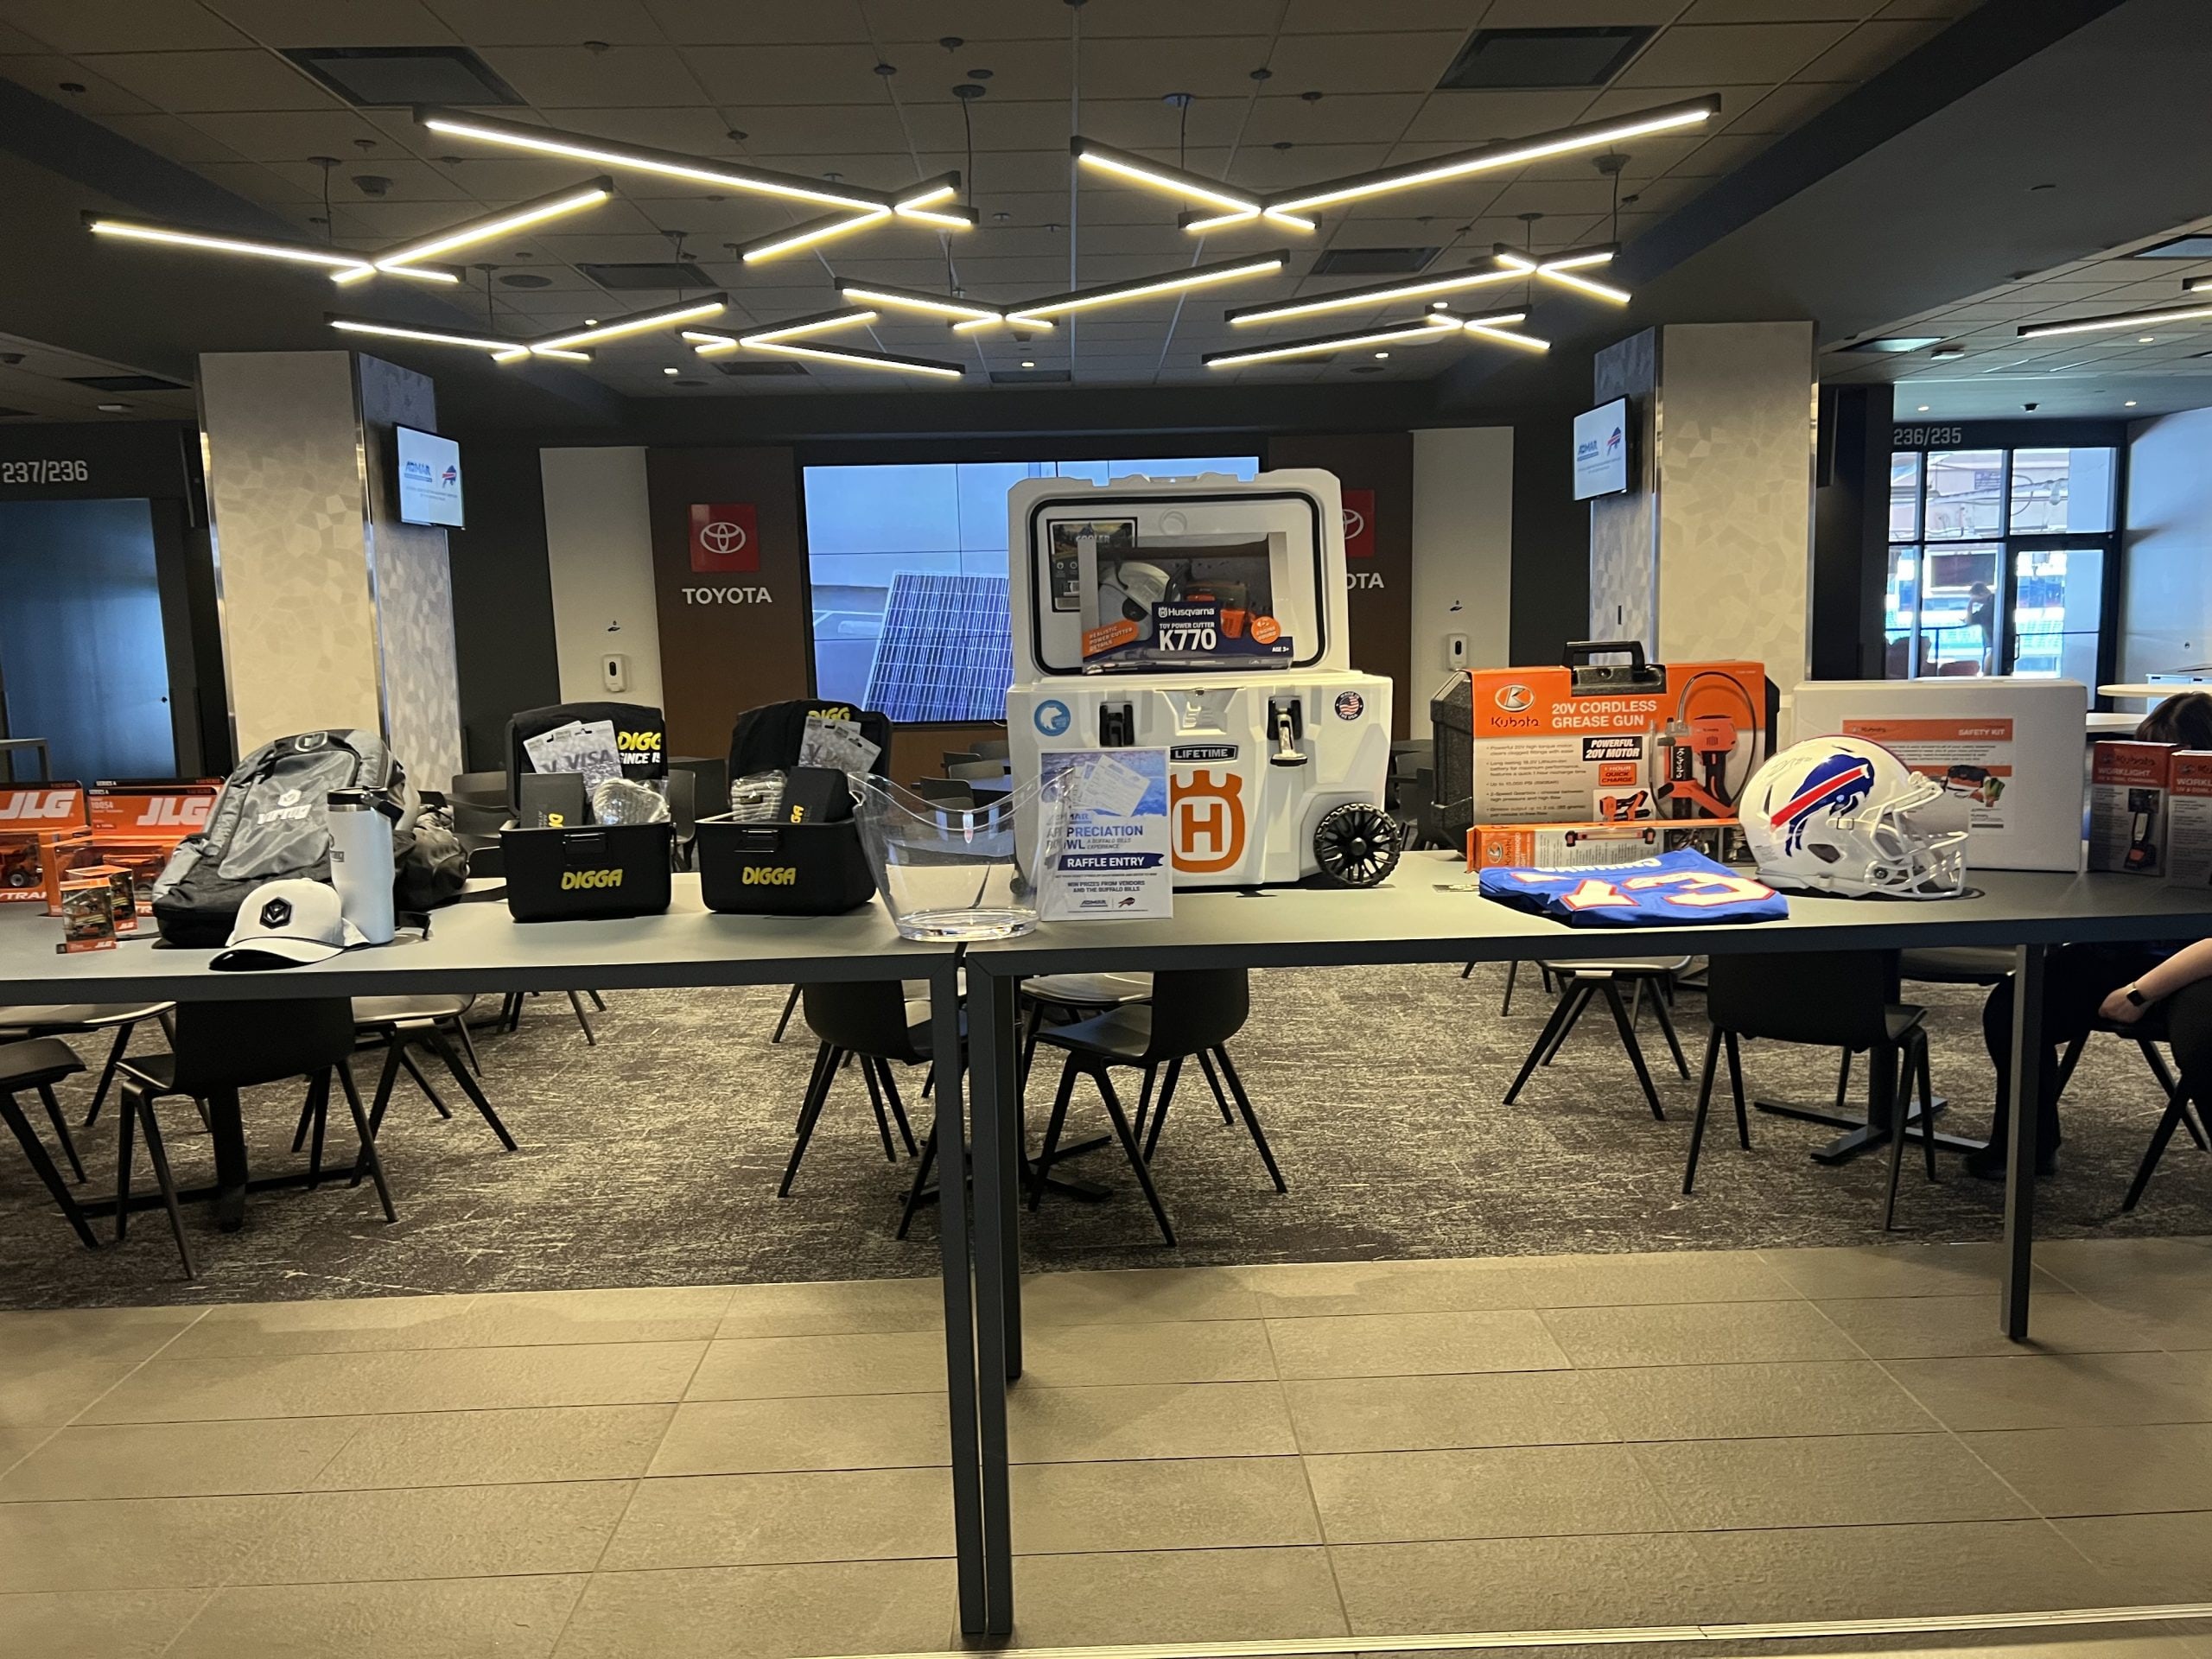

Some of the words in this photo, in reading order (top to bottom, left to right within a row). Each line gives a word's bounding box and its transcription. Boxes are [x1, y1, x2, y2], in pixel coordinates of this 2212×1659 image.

[1893, 427, 1961, 446] 236/235
[2, 460, 88, 484] 237/236
[682, 587, 773, 604] TOYOTA
[1168, 607, 1215, 618] Husqvarna
[1160, 629, 1217, 651] K770
[1552, 702, 1576, 715] 20V
[1580, 701, 1656, 713] CORDLESS
[1491, 716, 1540, 728] Kubota
[1552, 715, 1609, 728] GREASE
[1612, 715, 1643, 726] GUN
[1591, 739, 1634, 748] POWERFUL
[563, 749, 611, 769] VISA
[1174, 749, 1229, 760] LIFETIME
[1586, 749, 1604, 759] 20V
[1605, 748, 1640, 758] MOTOR
[1675, 747, 1685, 779] Kubota
[2098, 767, 2151, 776] WORKLIGHT
[0, 791, 76, 818] JLG
[137, 797, 212, 825] JLG
[1067, 857, 1107, 868] RAFFLE
[1109, 856, 1145, 867] ENTRY
[562, 869, 623, 889] DIGGA
[742, 867, 797, 885] DIGGA
